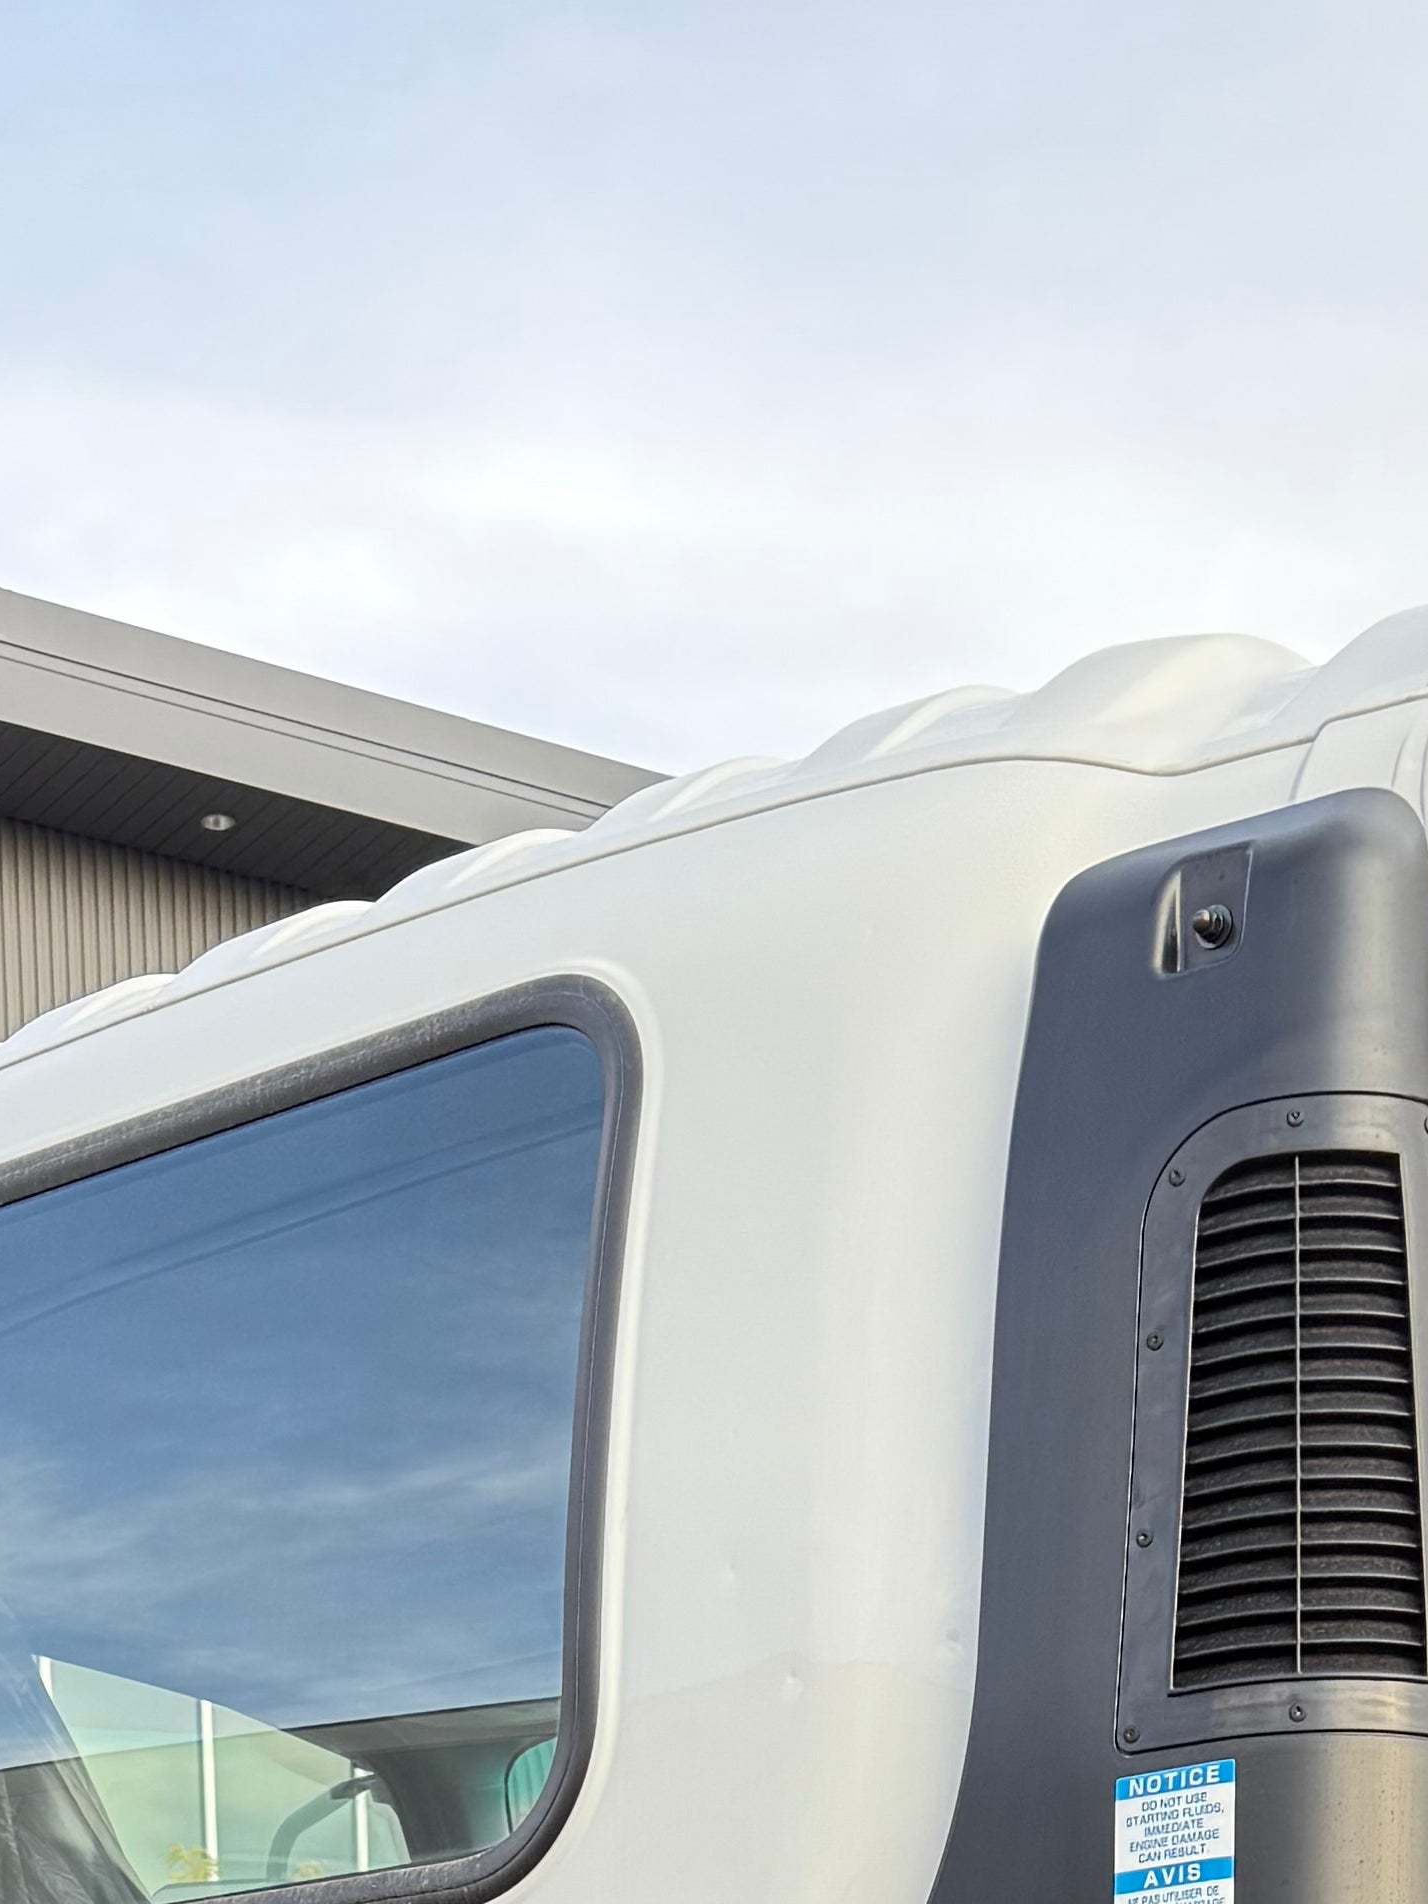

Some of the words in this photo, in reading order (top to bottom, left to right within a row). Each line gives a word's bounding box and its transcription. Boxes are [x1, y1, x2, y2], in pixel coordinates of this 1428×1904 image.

[1129, 1764, 1221, 1797] NOTICE
[1142, 1800, 1157, 1812] DO
[1160, 1795, 1183, 1808] NOT
[1185, 1792, 1207, 1804] USE
[1126, 1809, 1179, 1828] STARTING
[1144, 1818, 1204, 1837] IMMEDIATE
[1130, 1837, 1169, 1853] ENGINE
[1172, 1828, 1220, 1846] DAMAGE
[1139, 1850, 1161, 1863] CAN
[1143, 1863, 1201, 1889] AVIS
[1142, 1894, 1160, 1904] PAS
[1162, 1888, 1202, 1902] UTILISER
[1206, 1885, 1219, 1896] DE
